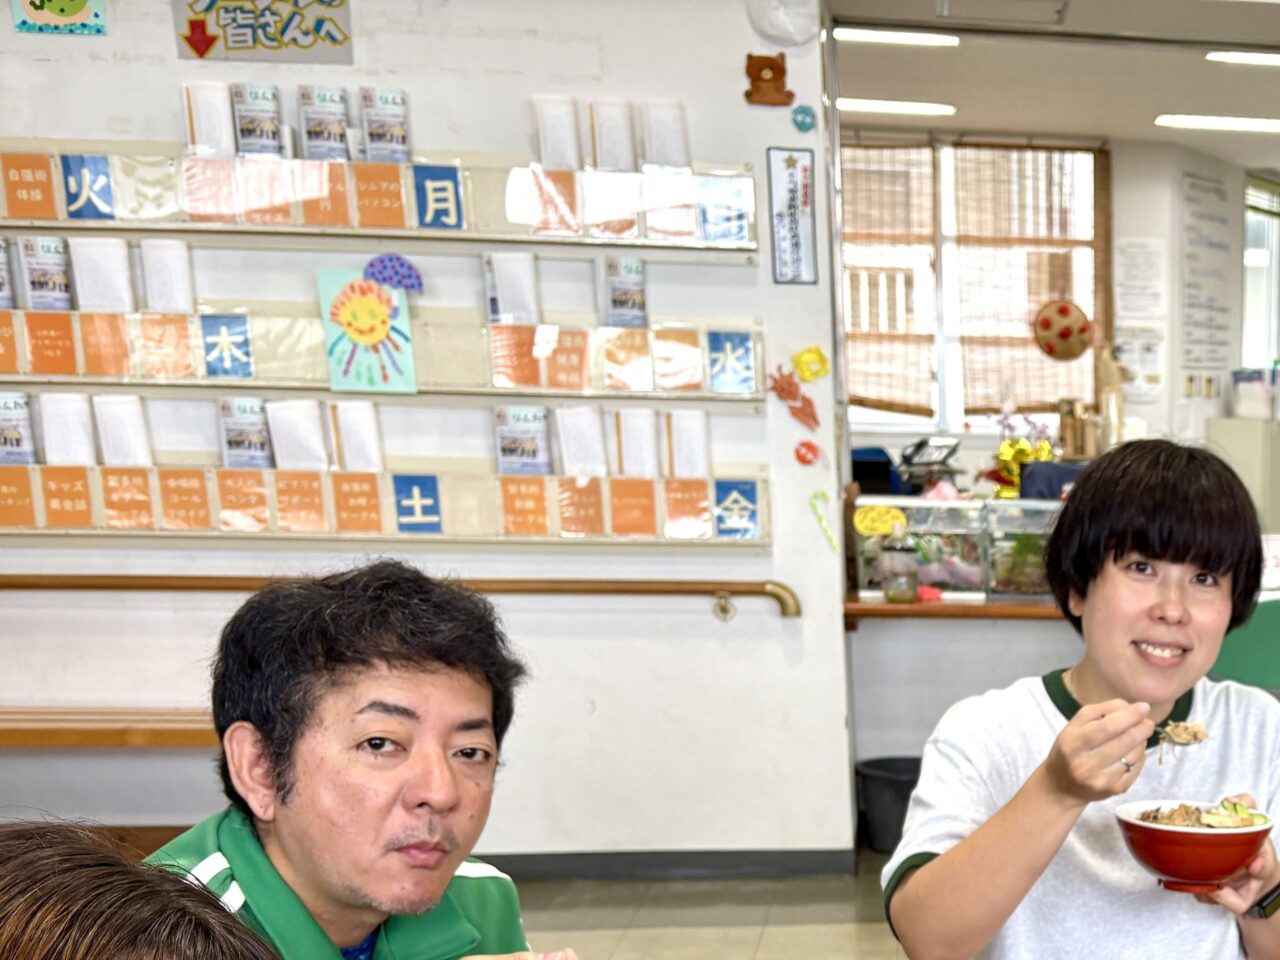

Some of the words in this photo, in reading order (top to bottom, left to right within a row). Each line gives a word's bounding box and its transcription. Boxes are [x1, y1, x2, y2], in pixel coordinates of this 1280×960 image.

[217, 7, 348, 50] 皆さんへ
[68, 168, 113, 213] 火
[424, 180, 458, 225] 月
[205, 326, 249, 369] 木
[711, 341, 754, 381] 水
[46, 480, 85, 493] キッズ
[399, 485, 440, 523] 土
[717, 490, 756, 530] 金
